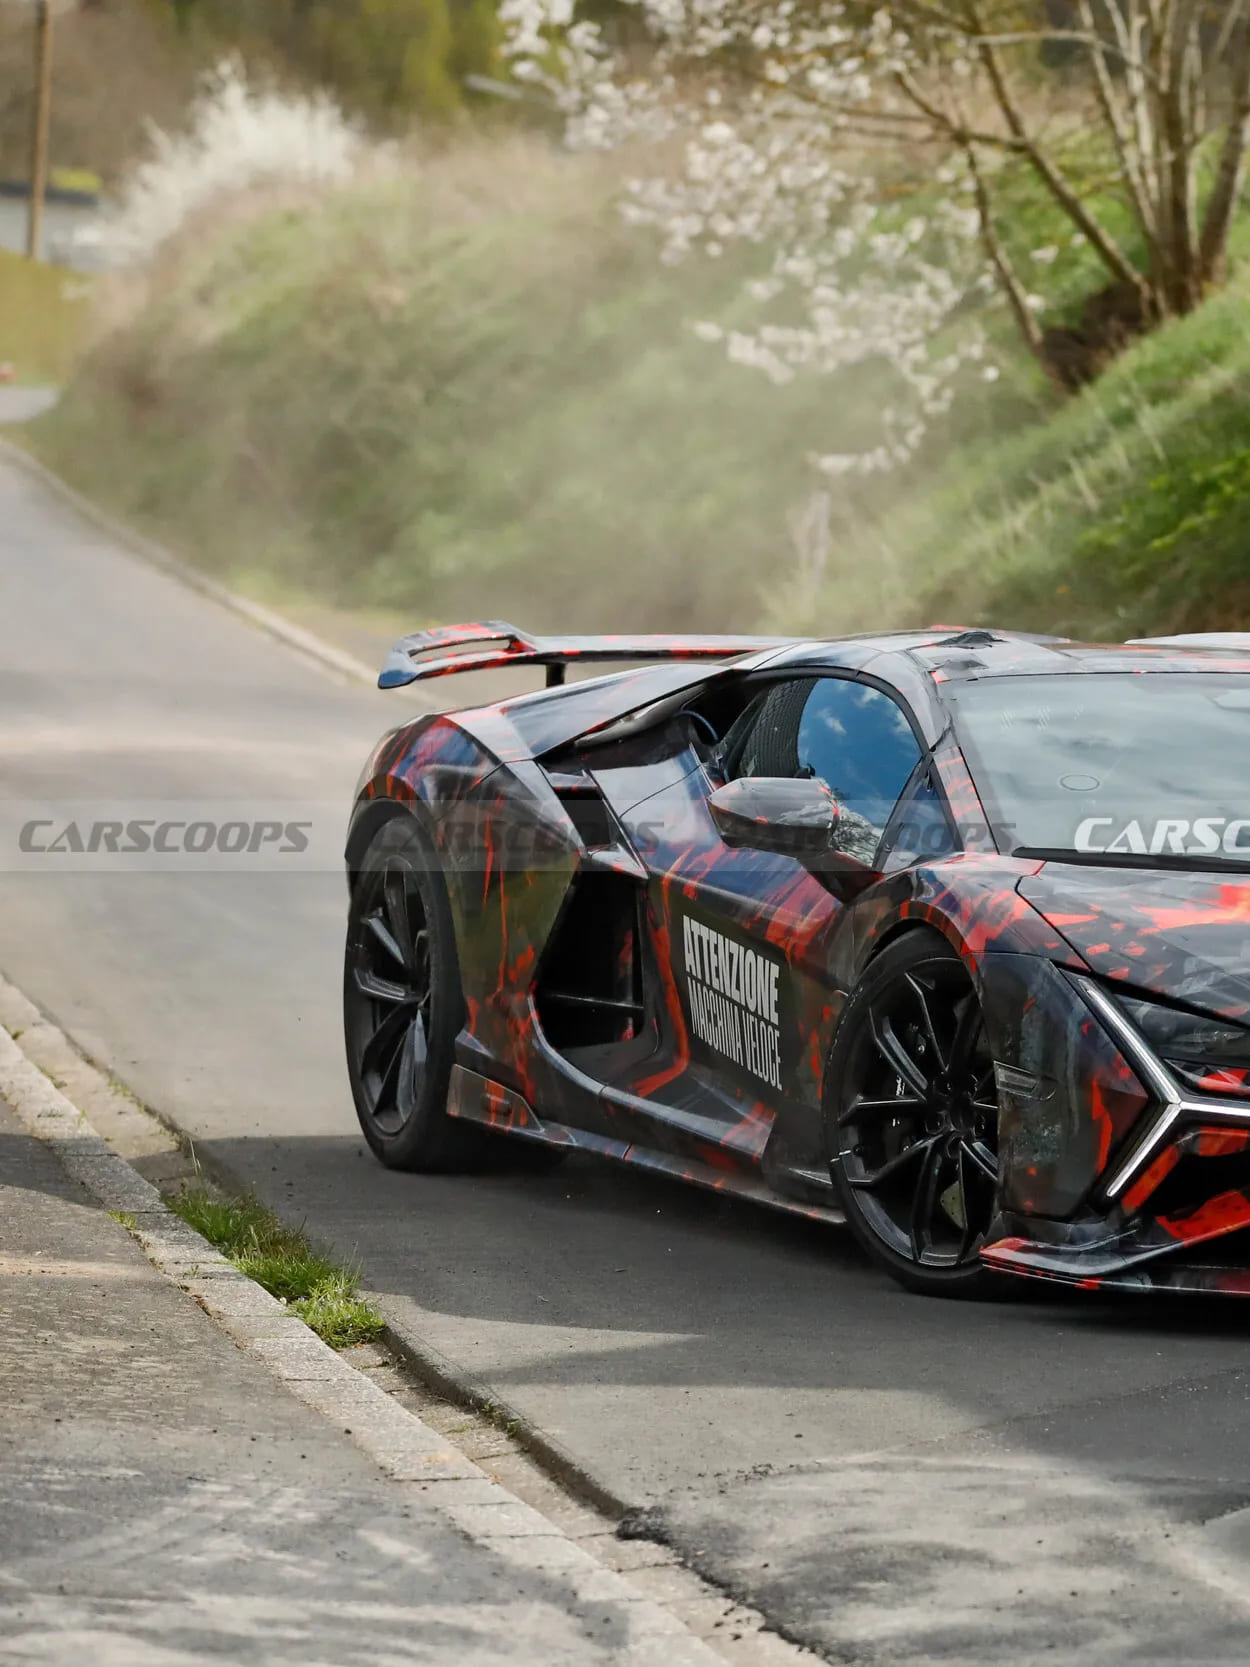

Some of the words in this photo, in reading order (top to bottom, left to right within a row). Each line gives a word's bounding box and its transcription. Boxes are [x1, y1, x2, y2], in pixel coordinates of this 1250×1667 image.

[683, 914, 780, 1026] ATTENZIONE
[687, 975, 744, 1067] MACCHINA
[742, 1010, 783, 1091] VELOCE
